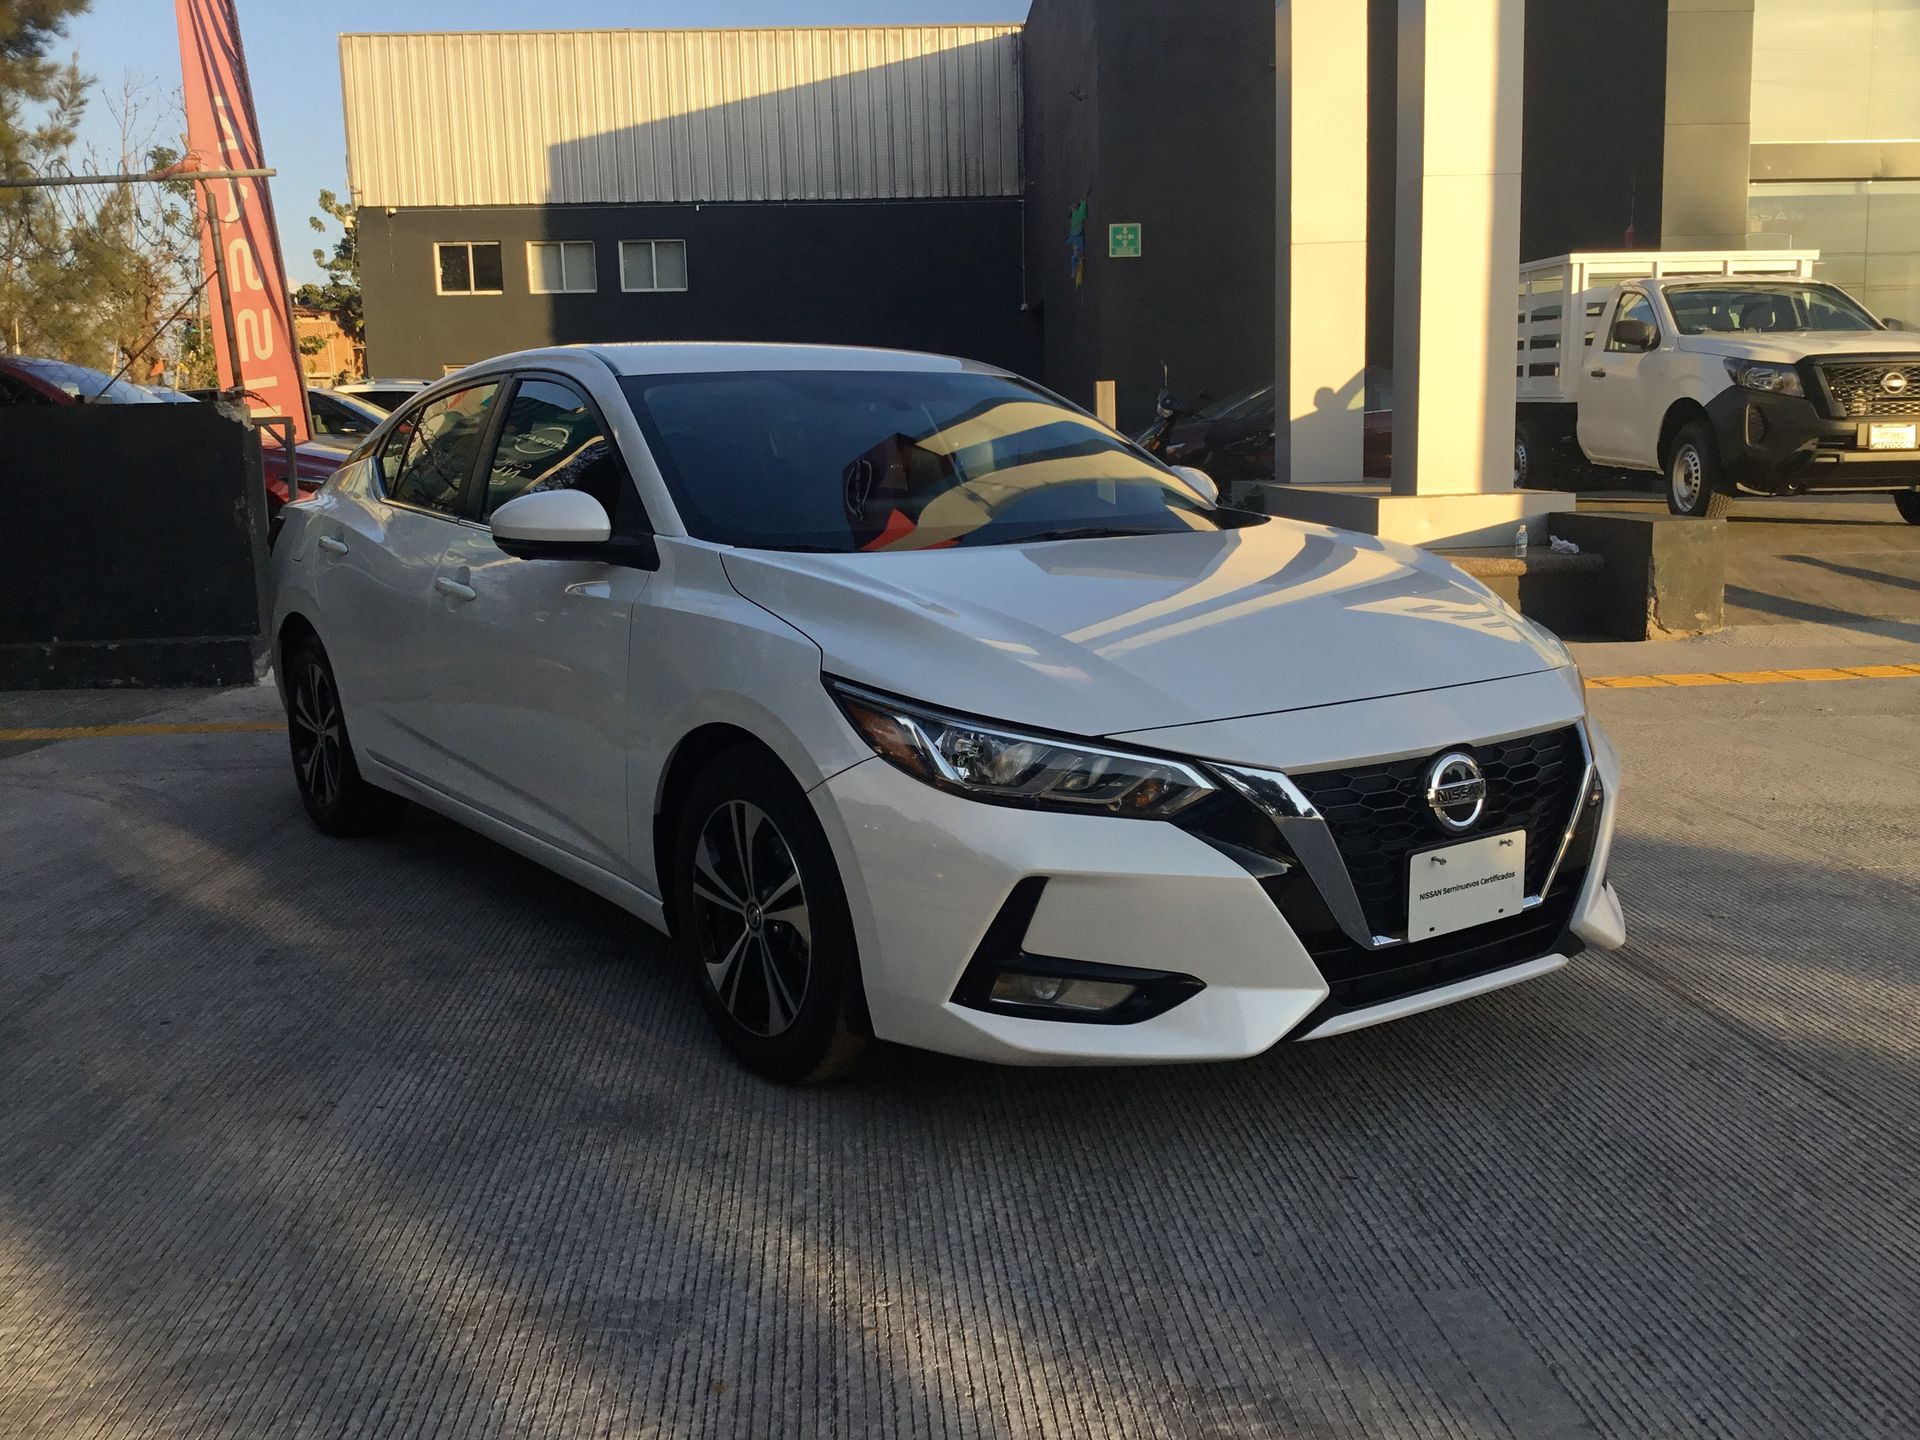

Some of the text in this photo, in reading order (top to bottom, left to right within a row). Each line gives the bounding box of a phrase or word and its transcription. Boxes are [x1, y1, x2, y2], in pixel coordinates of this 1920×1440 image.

[1437, 782, 1484, 802] NISSAN
[1419, 871, 1515, 901] NISSAN Seminuevos Certificados
